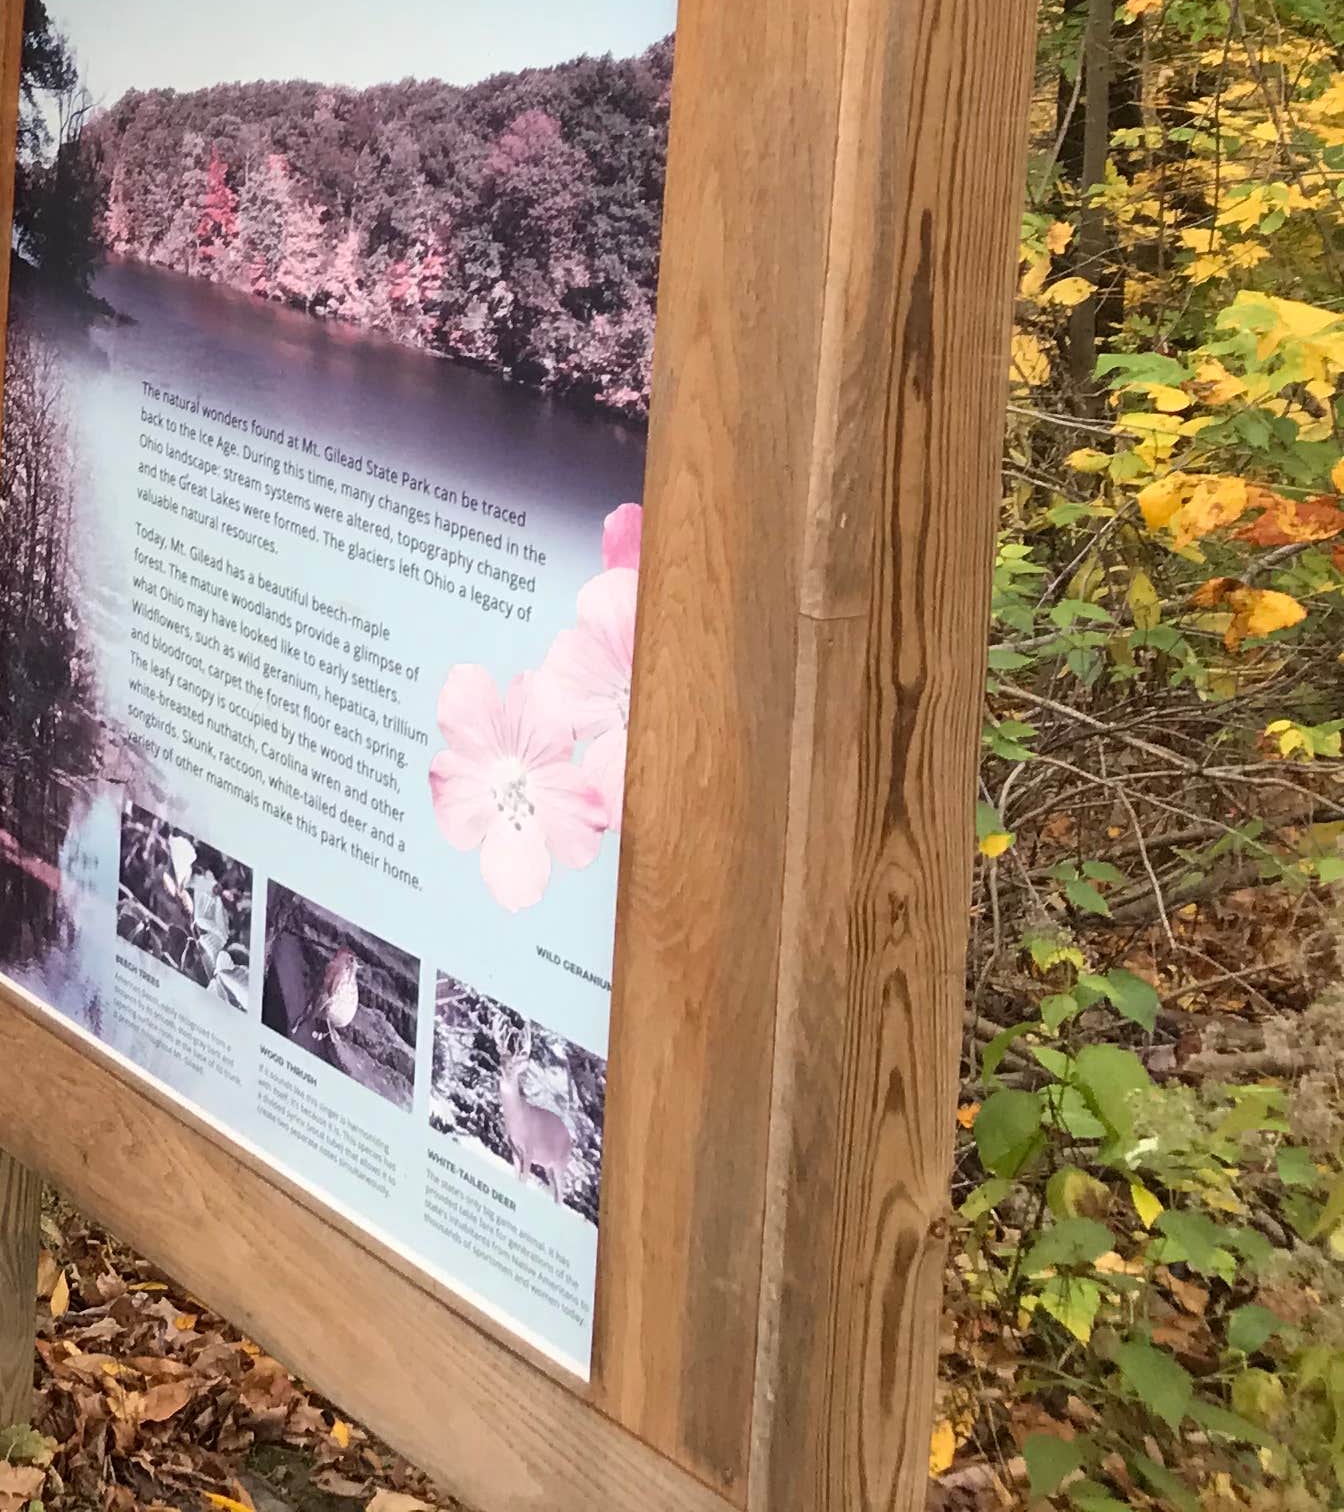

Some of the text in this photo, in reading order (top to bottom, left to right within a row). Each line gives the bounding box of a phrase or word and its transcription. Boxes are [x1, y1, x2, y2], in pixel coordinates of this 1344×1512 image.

[141, 380, 526, 527] The natural wonders found at Mt. Gilead State Park can be traced
[135, 520, 390, 641] Today, Mt. Gilead has a beautiful beech-maple
[126, 730, 422, 891] variety of other mammals make this park their home.
[536, 945, 561, 965] WILD
[259, 1044, 317, 1087] WOOD THRUSH
[428, 1149, 516, 1212] WHITE-TAILED DEER
